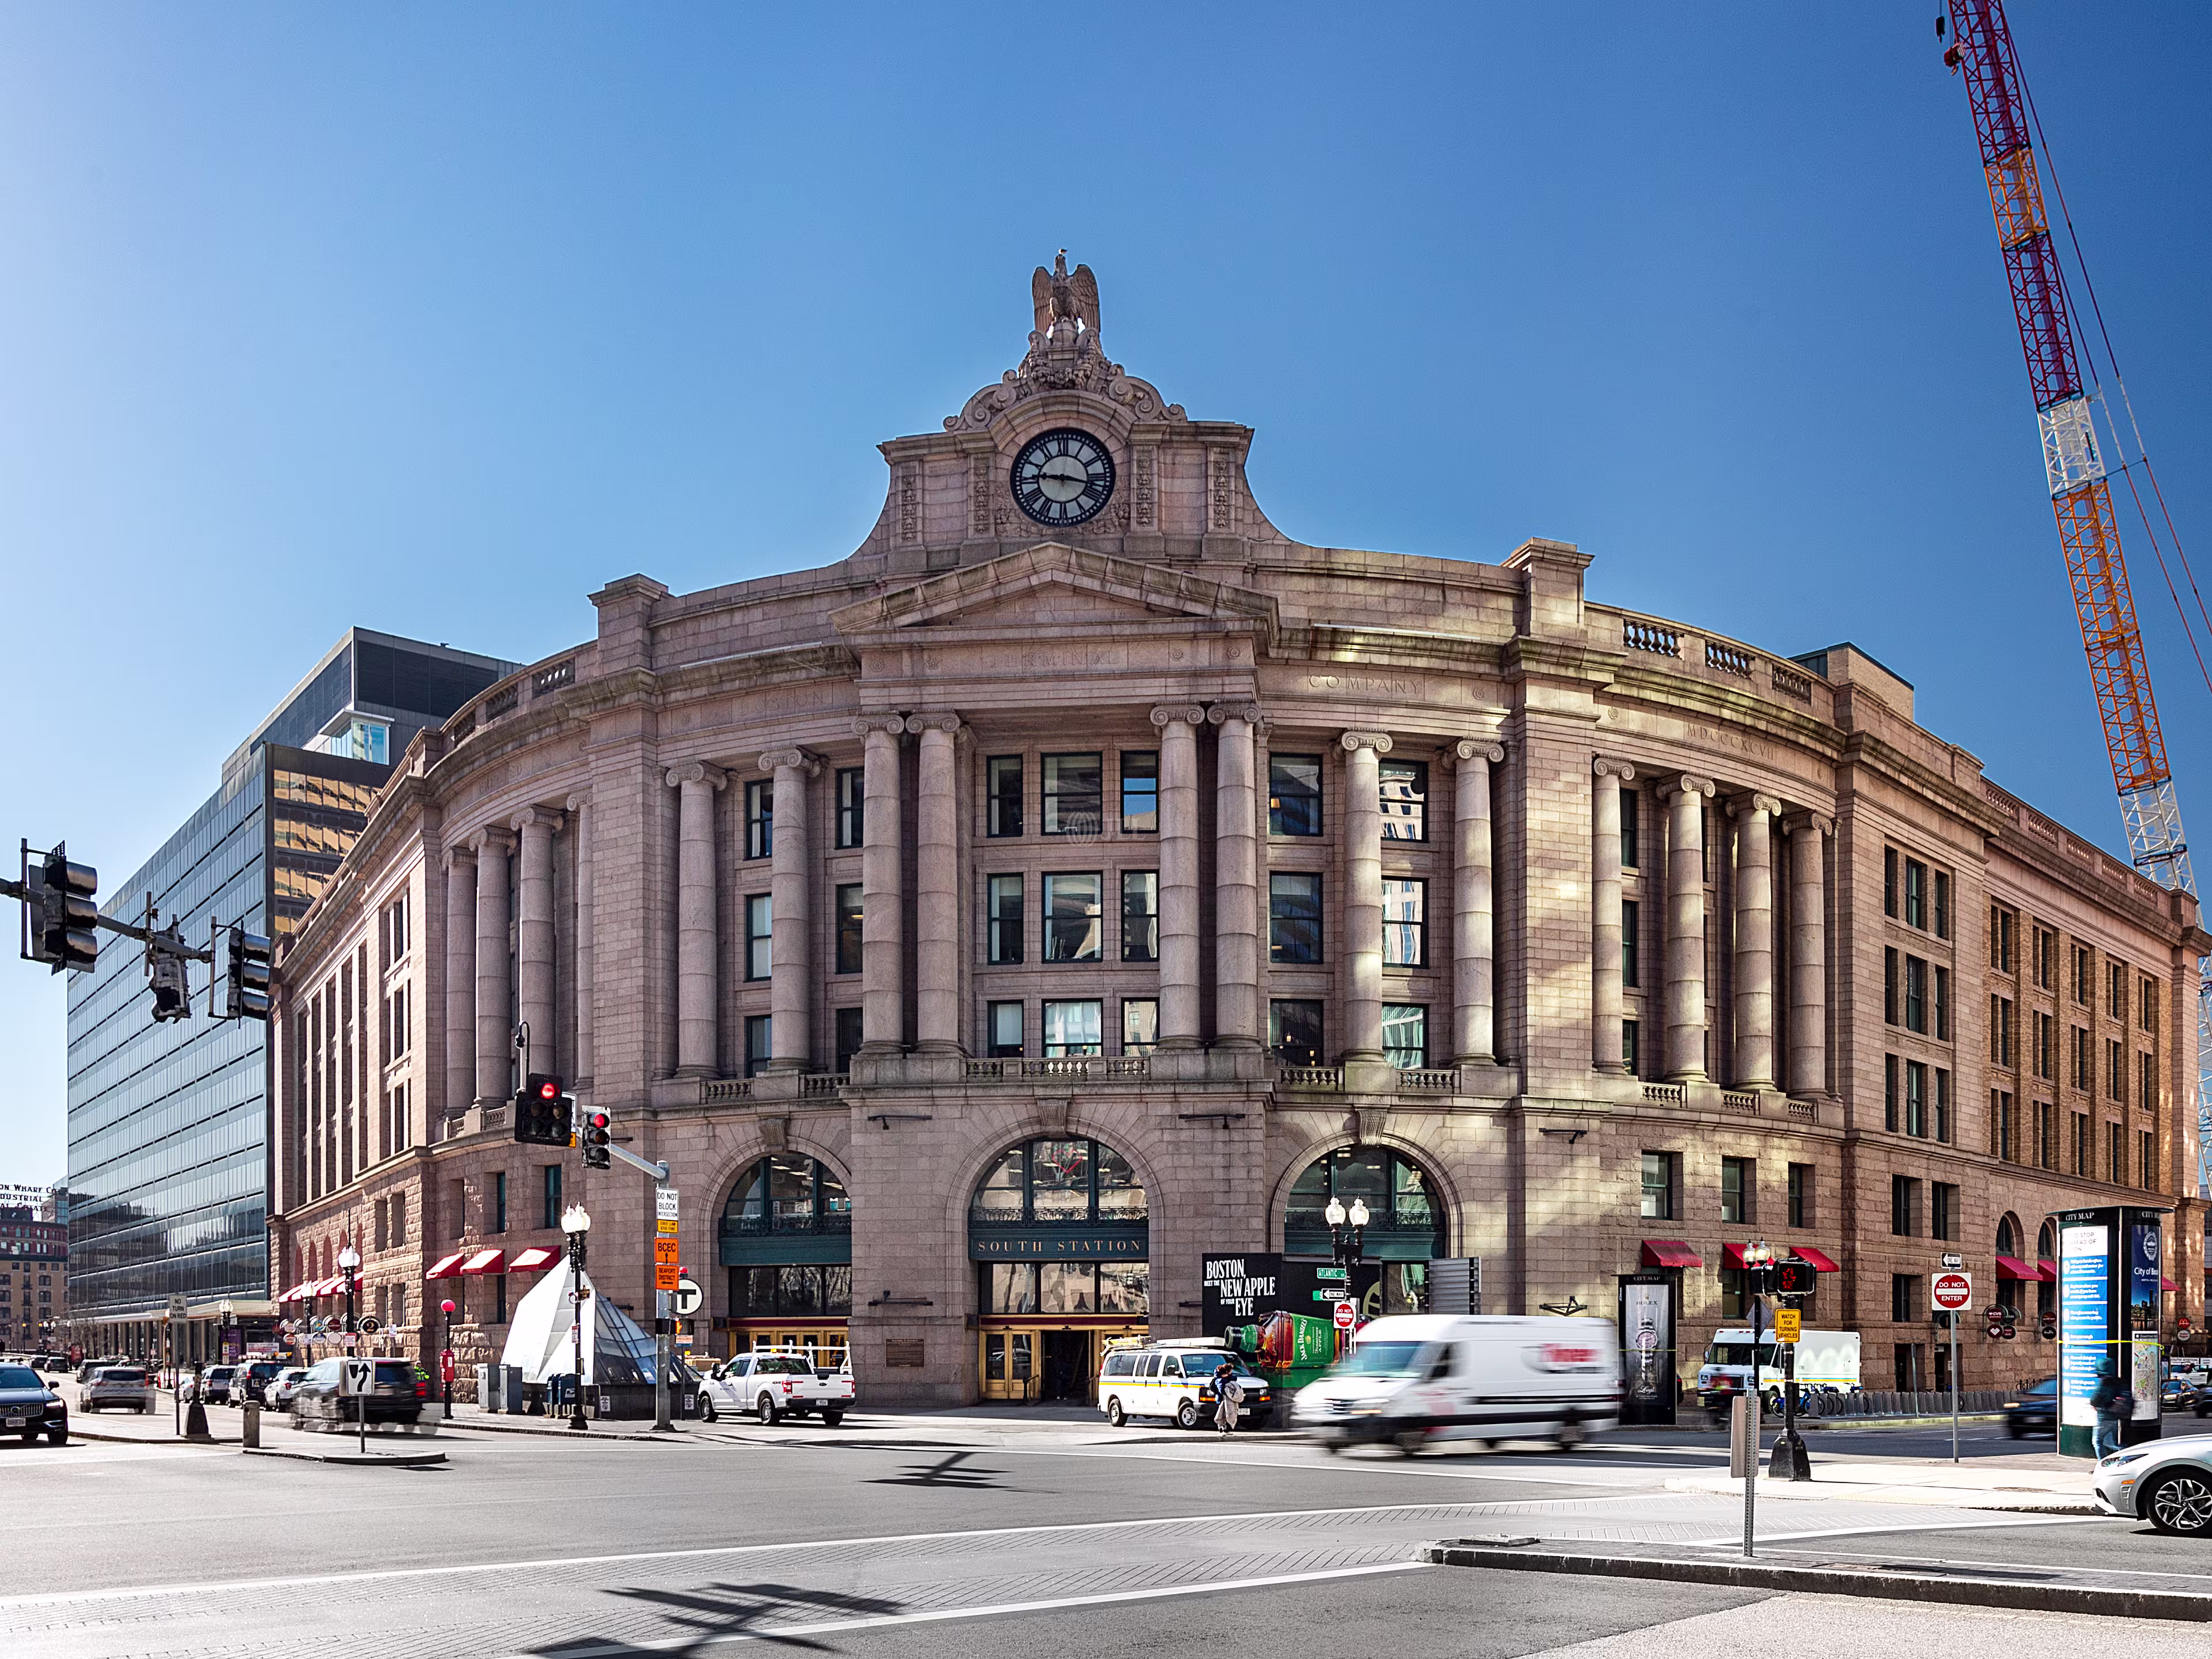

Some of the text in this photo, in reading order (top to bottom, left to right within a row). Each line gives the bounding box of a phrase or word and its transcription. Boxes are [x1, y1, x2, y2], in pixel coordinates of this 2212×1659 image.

[1309, 675, 1421, 694] COMPANY
[1687, 724, 1774, 760] MDCCCXCVII
[2078, 1212, 2094, 1220] MAP
[658, 1243, 676, 1252] BCEC
[978, 1240, 1140, 1252] SOUTH STATION
[1206, 1259, 1246, 1279] BOSTON,
[1319, 1268, 1337, 1277] ATLANTIC
[2134, 1267, 2145, 1277] City
[1220, 1278, 1243, 1297] NEW
[1244, 1277, 1275, 1296] APPLE
[673, 1289, 696, 1309] T
[1235, 1297, 1253, 1316] EYE
[366, 1322, 374, 1331] 2
[1299, 1344, 1308, 1360] JACK
